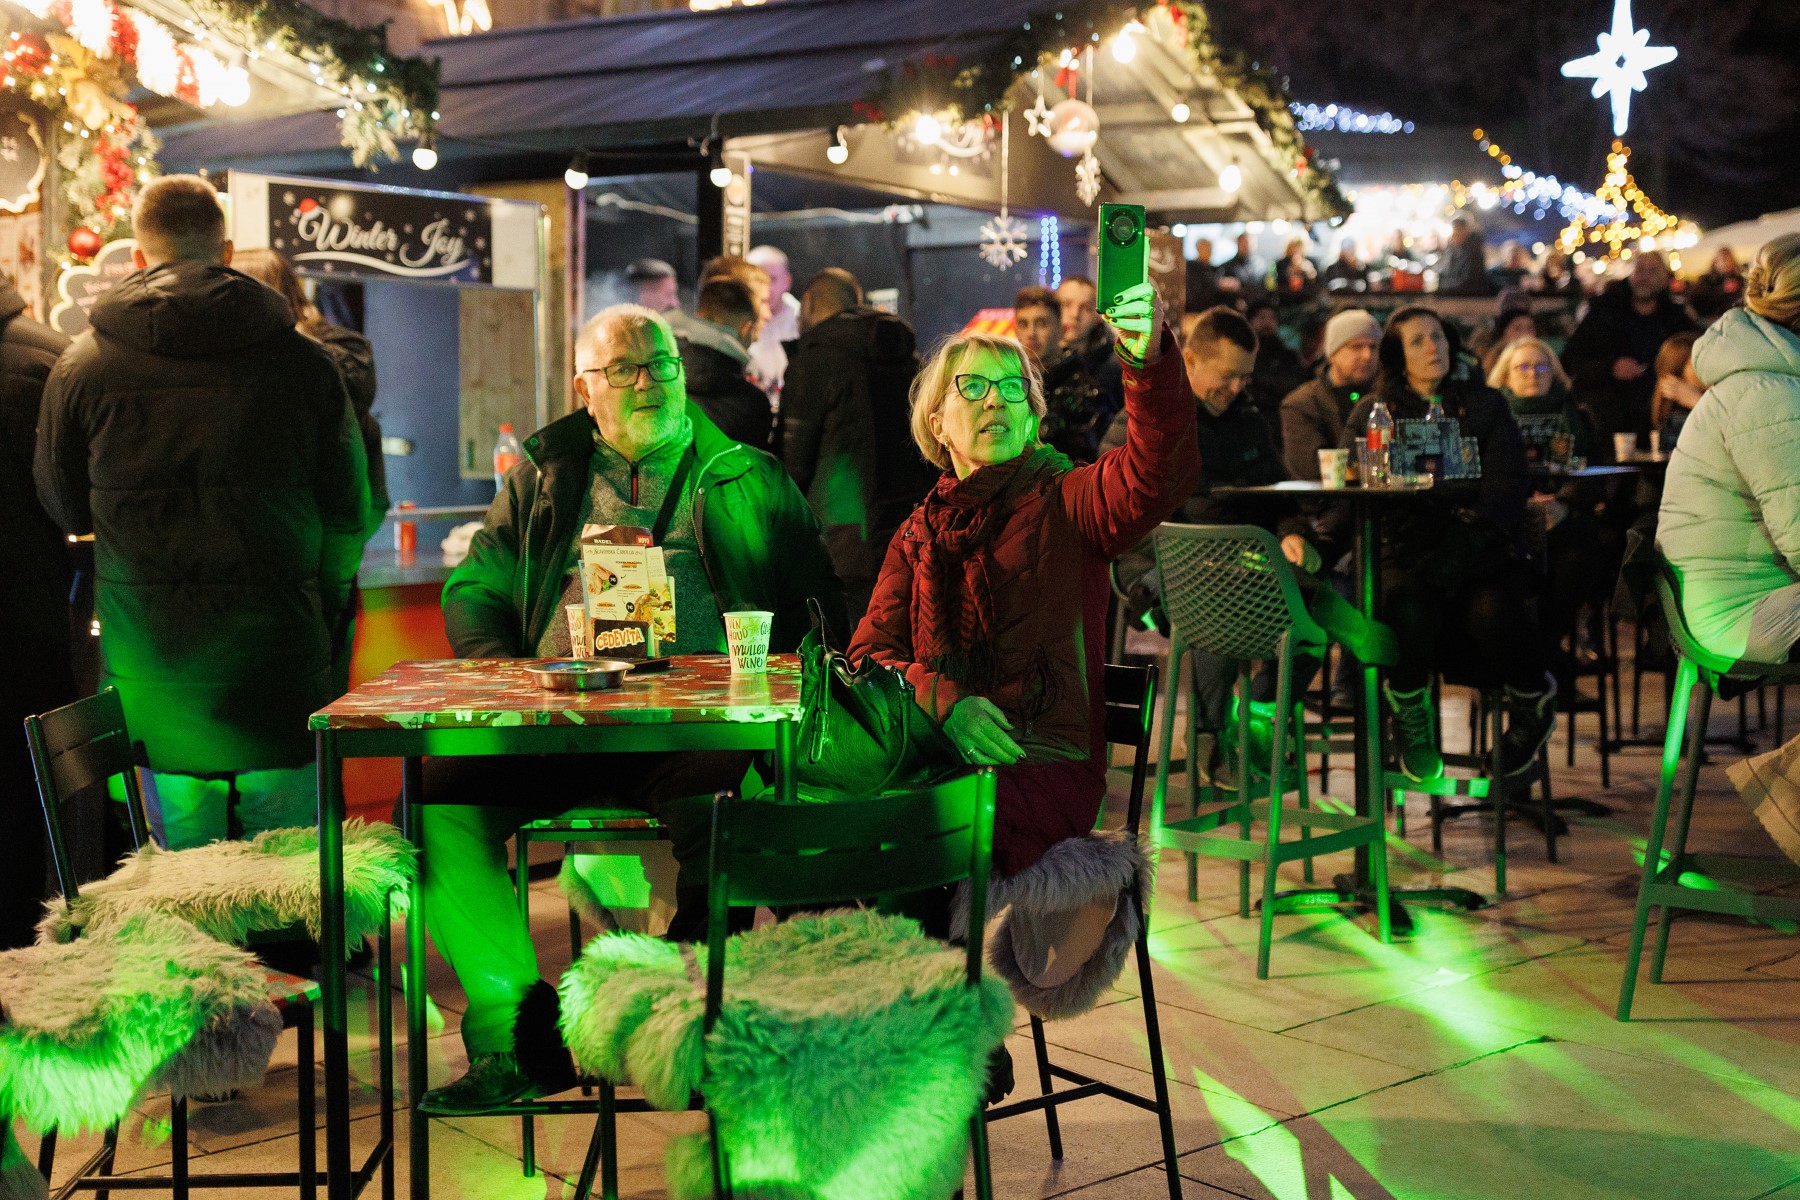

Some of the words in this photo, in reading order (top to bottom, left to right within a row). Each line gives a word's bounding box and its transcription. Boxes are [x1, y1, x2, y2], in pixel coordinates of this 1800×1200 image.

[297, 206, 398, 251] Winter
[399, 217, 464, 268] Joy
[595, 627, 645, 651] CEDEVITA
